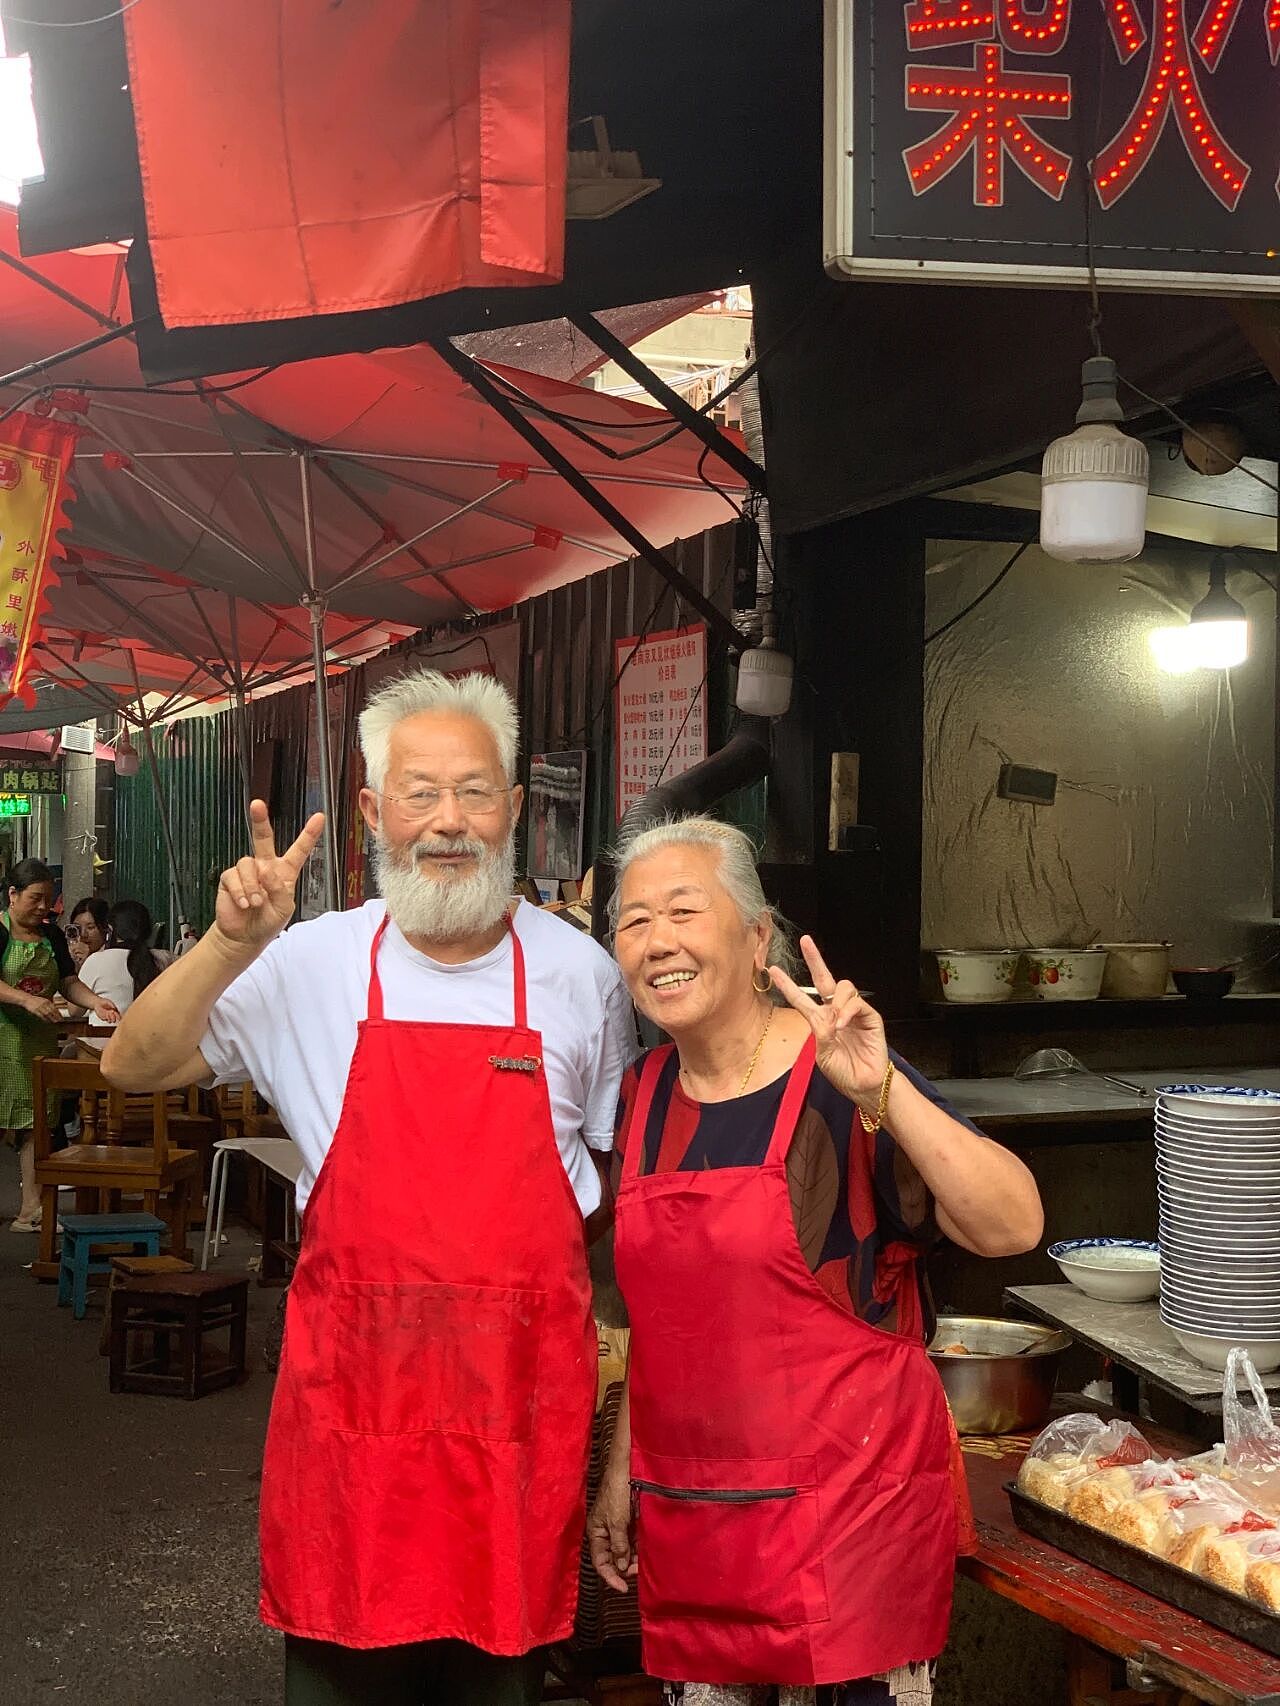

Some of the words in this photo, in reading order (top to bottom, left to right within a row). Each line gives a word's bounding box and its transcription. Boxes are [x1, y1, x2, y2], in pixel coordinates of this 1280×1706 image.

[902, 0, 1280, 212] 柴火
[0, 539, 35, 639] 外酥里嫩
